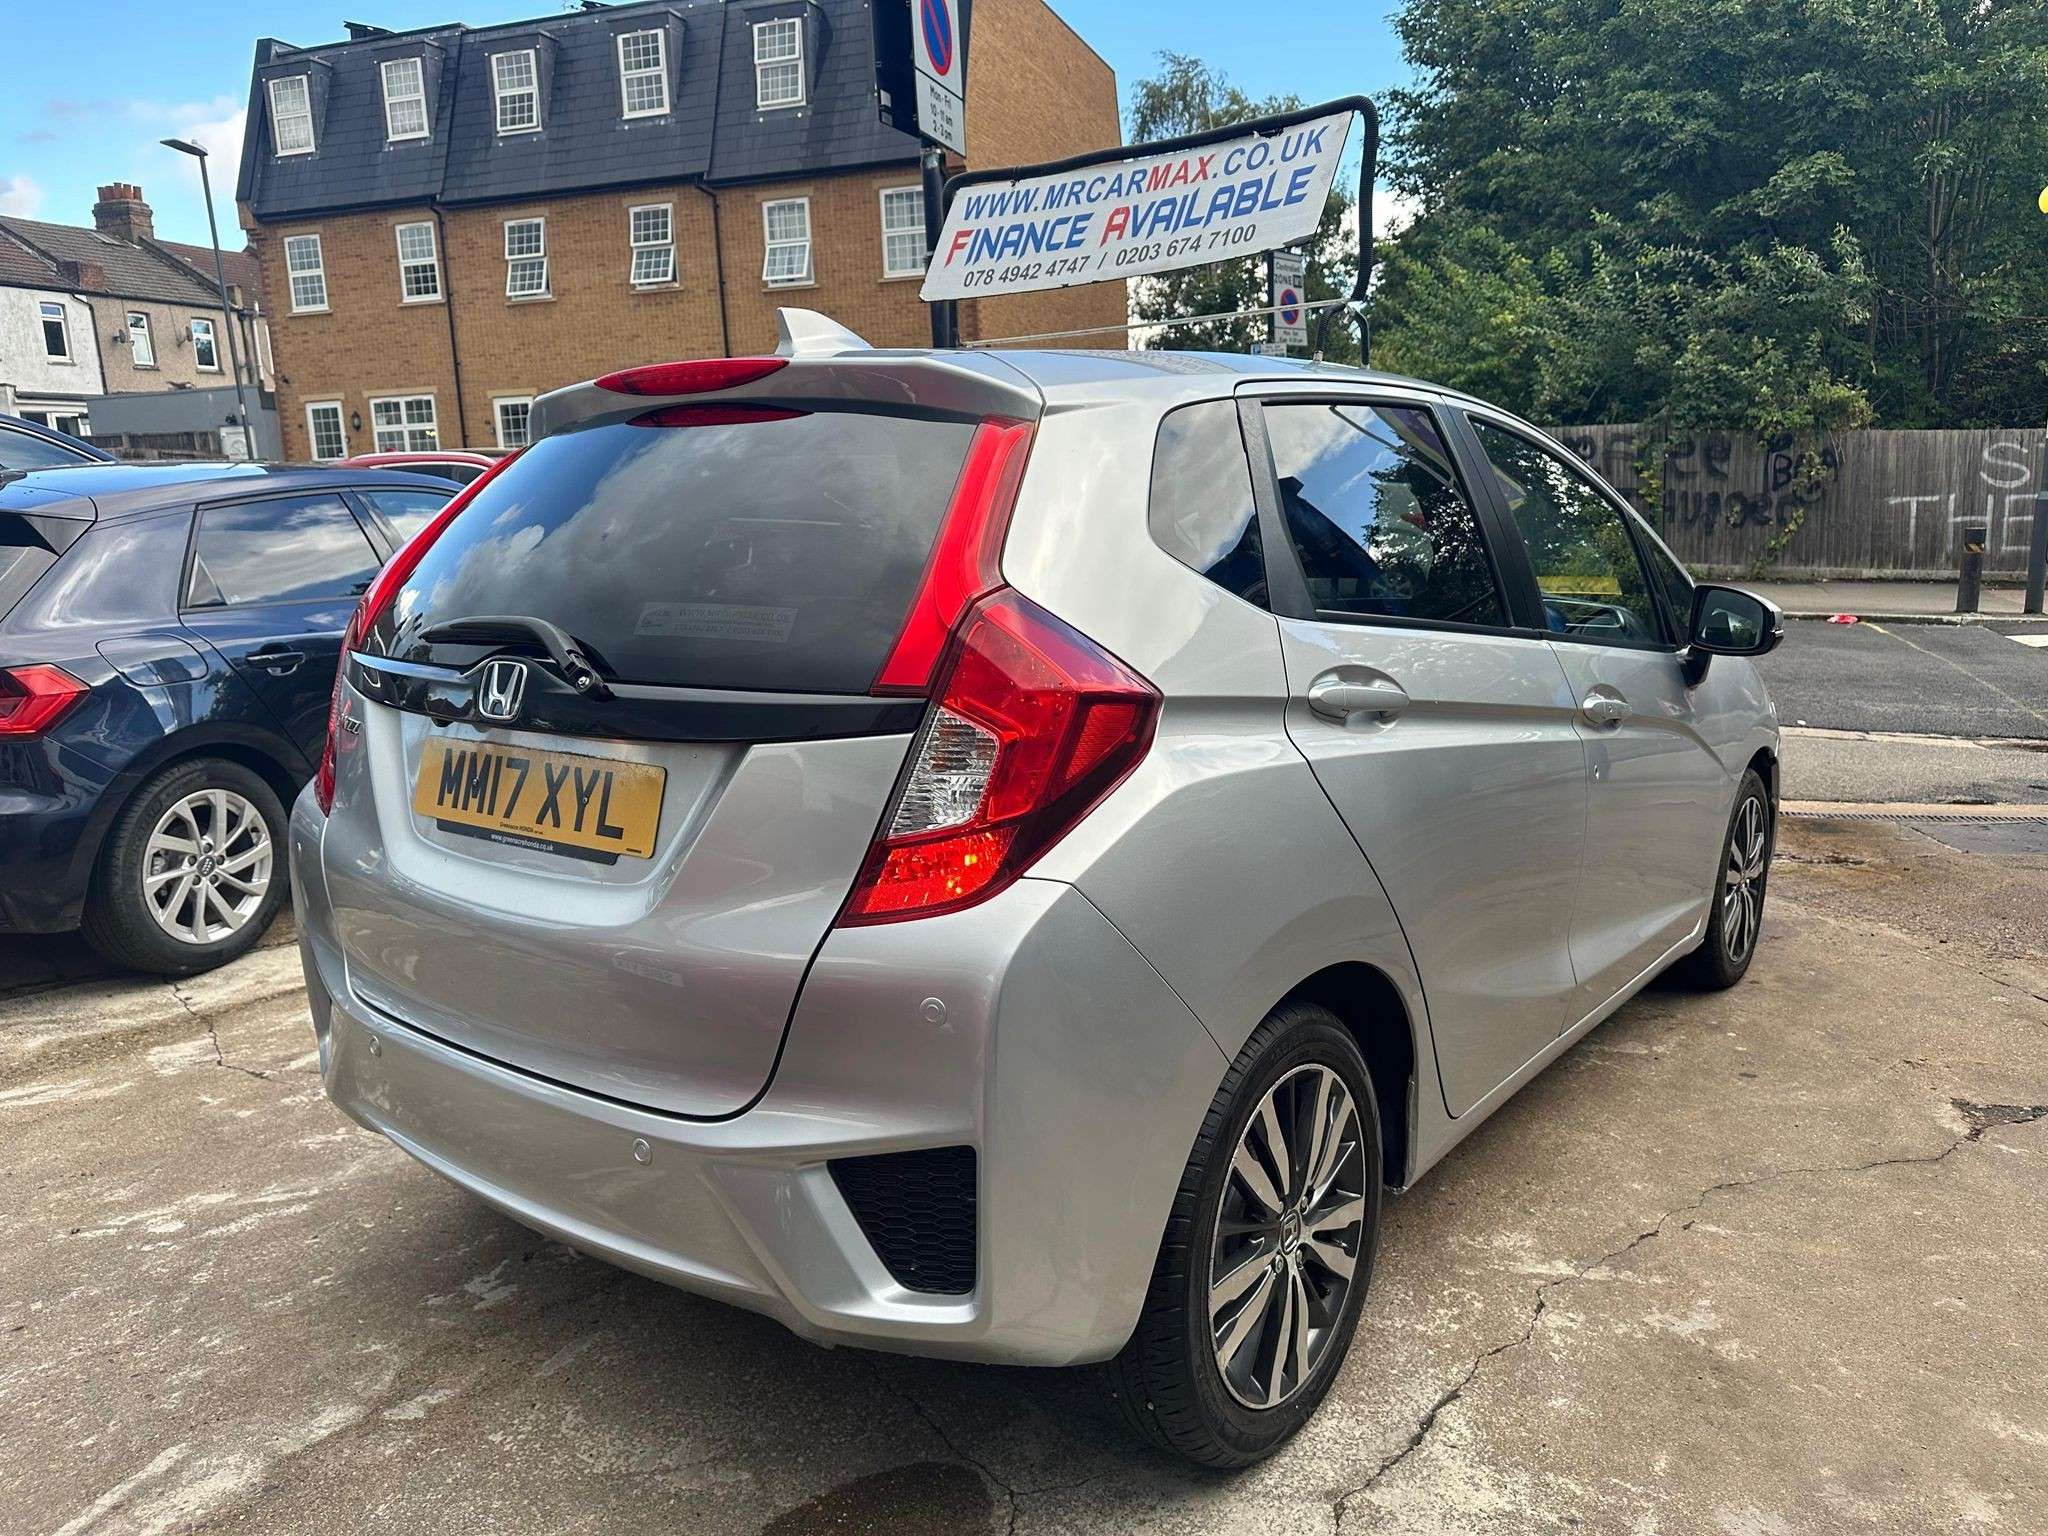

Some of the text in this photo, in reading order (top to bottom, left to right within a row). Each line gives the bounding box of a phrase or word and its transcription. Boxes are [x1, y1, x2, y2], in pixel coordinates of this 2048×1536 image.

[962, 125, 1331, 220] WWW.MRCARMAX.CO.UK
[944, 164, 1318, 268] FINANCE AVAILABLE
[963, 267, 996, 288] 078
[998, 262, 1041, 282] 4942
[1045, 255, 1090, 278] 4747
[1114, 244, 1161, 267] 0203
[1165, 235, 1203, 258] 674
[1208, 223, 1257, 251] 7100
[1980, 442, 2046, 489] S
[1887, 493, 2039, 553] THE
[436, 747, 625, 840] MM17 XYL
